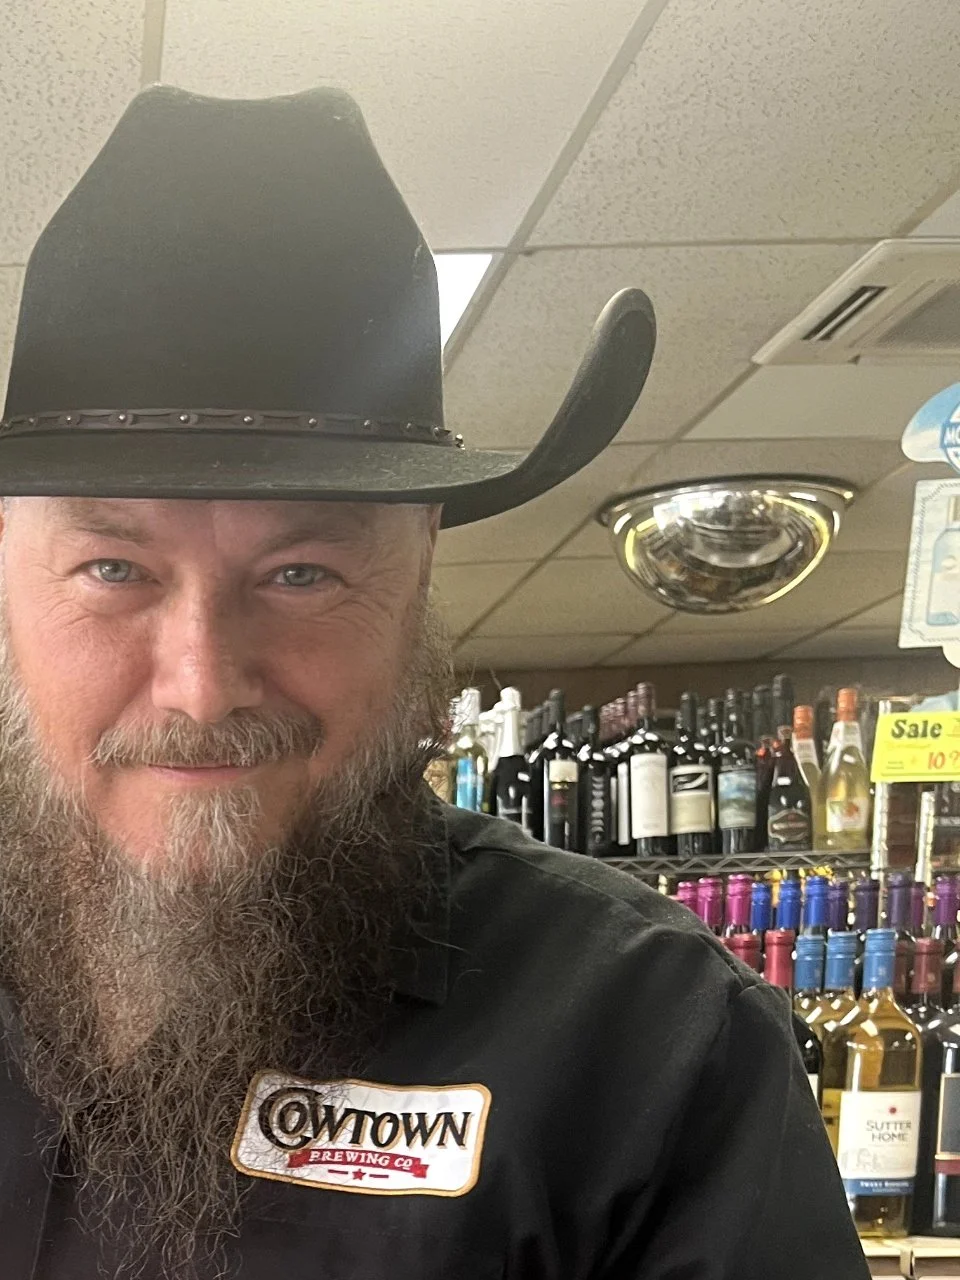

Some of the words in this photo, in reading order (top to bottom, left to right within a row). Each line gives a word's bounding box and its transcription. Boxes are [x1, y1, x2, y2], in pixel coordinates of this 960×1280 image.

[891, 718, 943, 739] Sale
[258, 1086, 471, 1149] COWTOWN
[866, 1120, 912, 1132] SUTTER
[872, 1132, 908, 1142] HOME
[309, 1149, 391, 1168] BREWING
